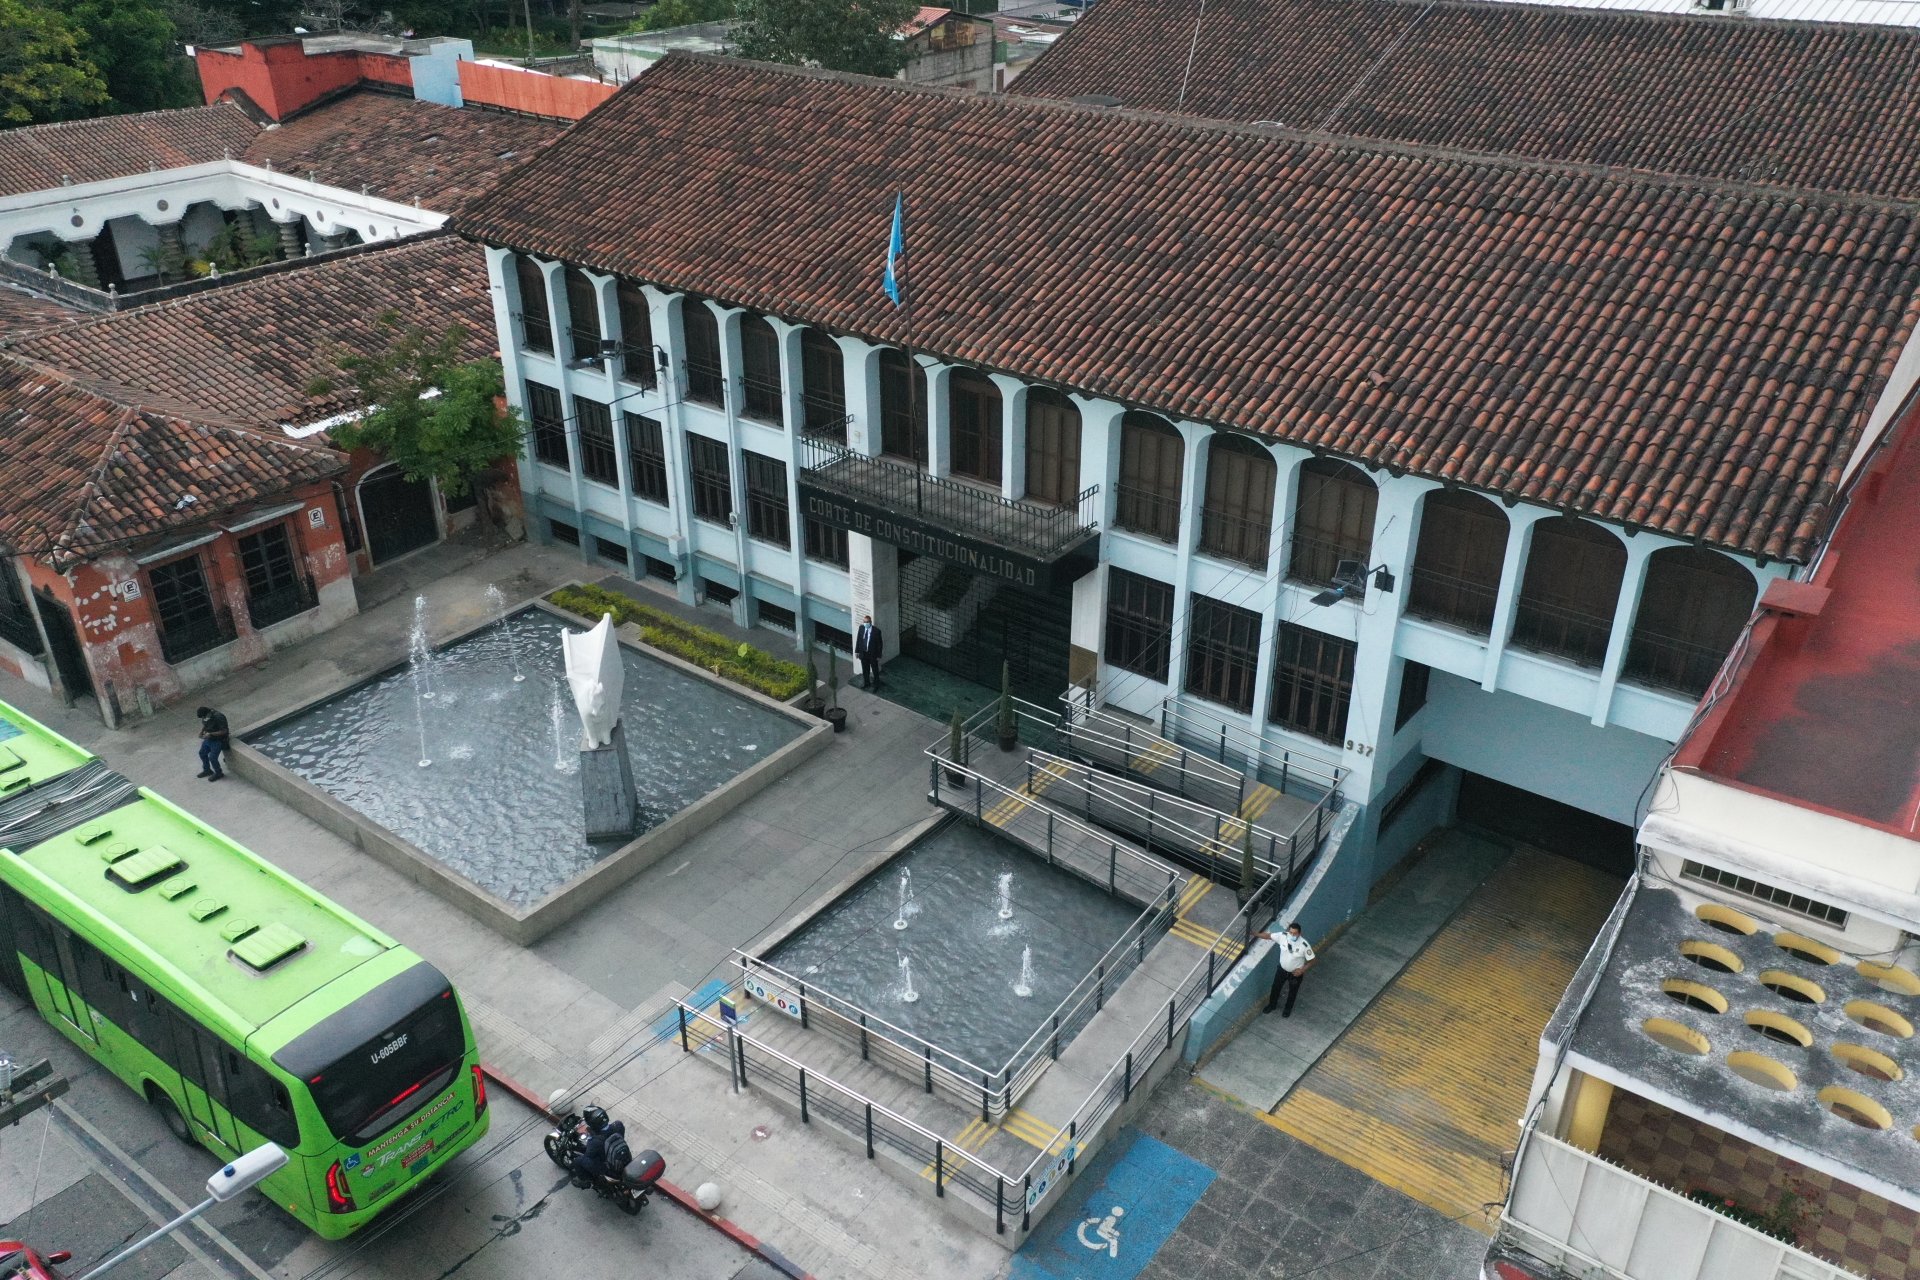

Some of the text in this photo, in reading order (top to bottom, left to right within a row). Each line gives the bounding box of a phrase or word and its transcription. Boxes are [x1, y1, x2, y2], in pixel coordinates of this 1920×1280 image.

[809, 496, 1035, 586] CORTE DE CONSTITUCIONALIDAD
[1346, 739, 1374, 757] 937
[370, 1033, 408, 1064] U-605BBF
[367, 1127, 409, 1157] MANTENGA
[410, 1119, 420, 1130] SU
[420, 1092, 455, 1121] DISTANCIA
[377, 1099, 464, 1168] TRANSMETRO
